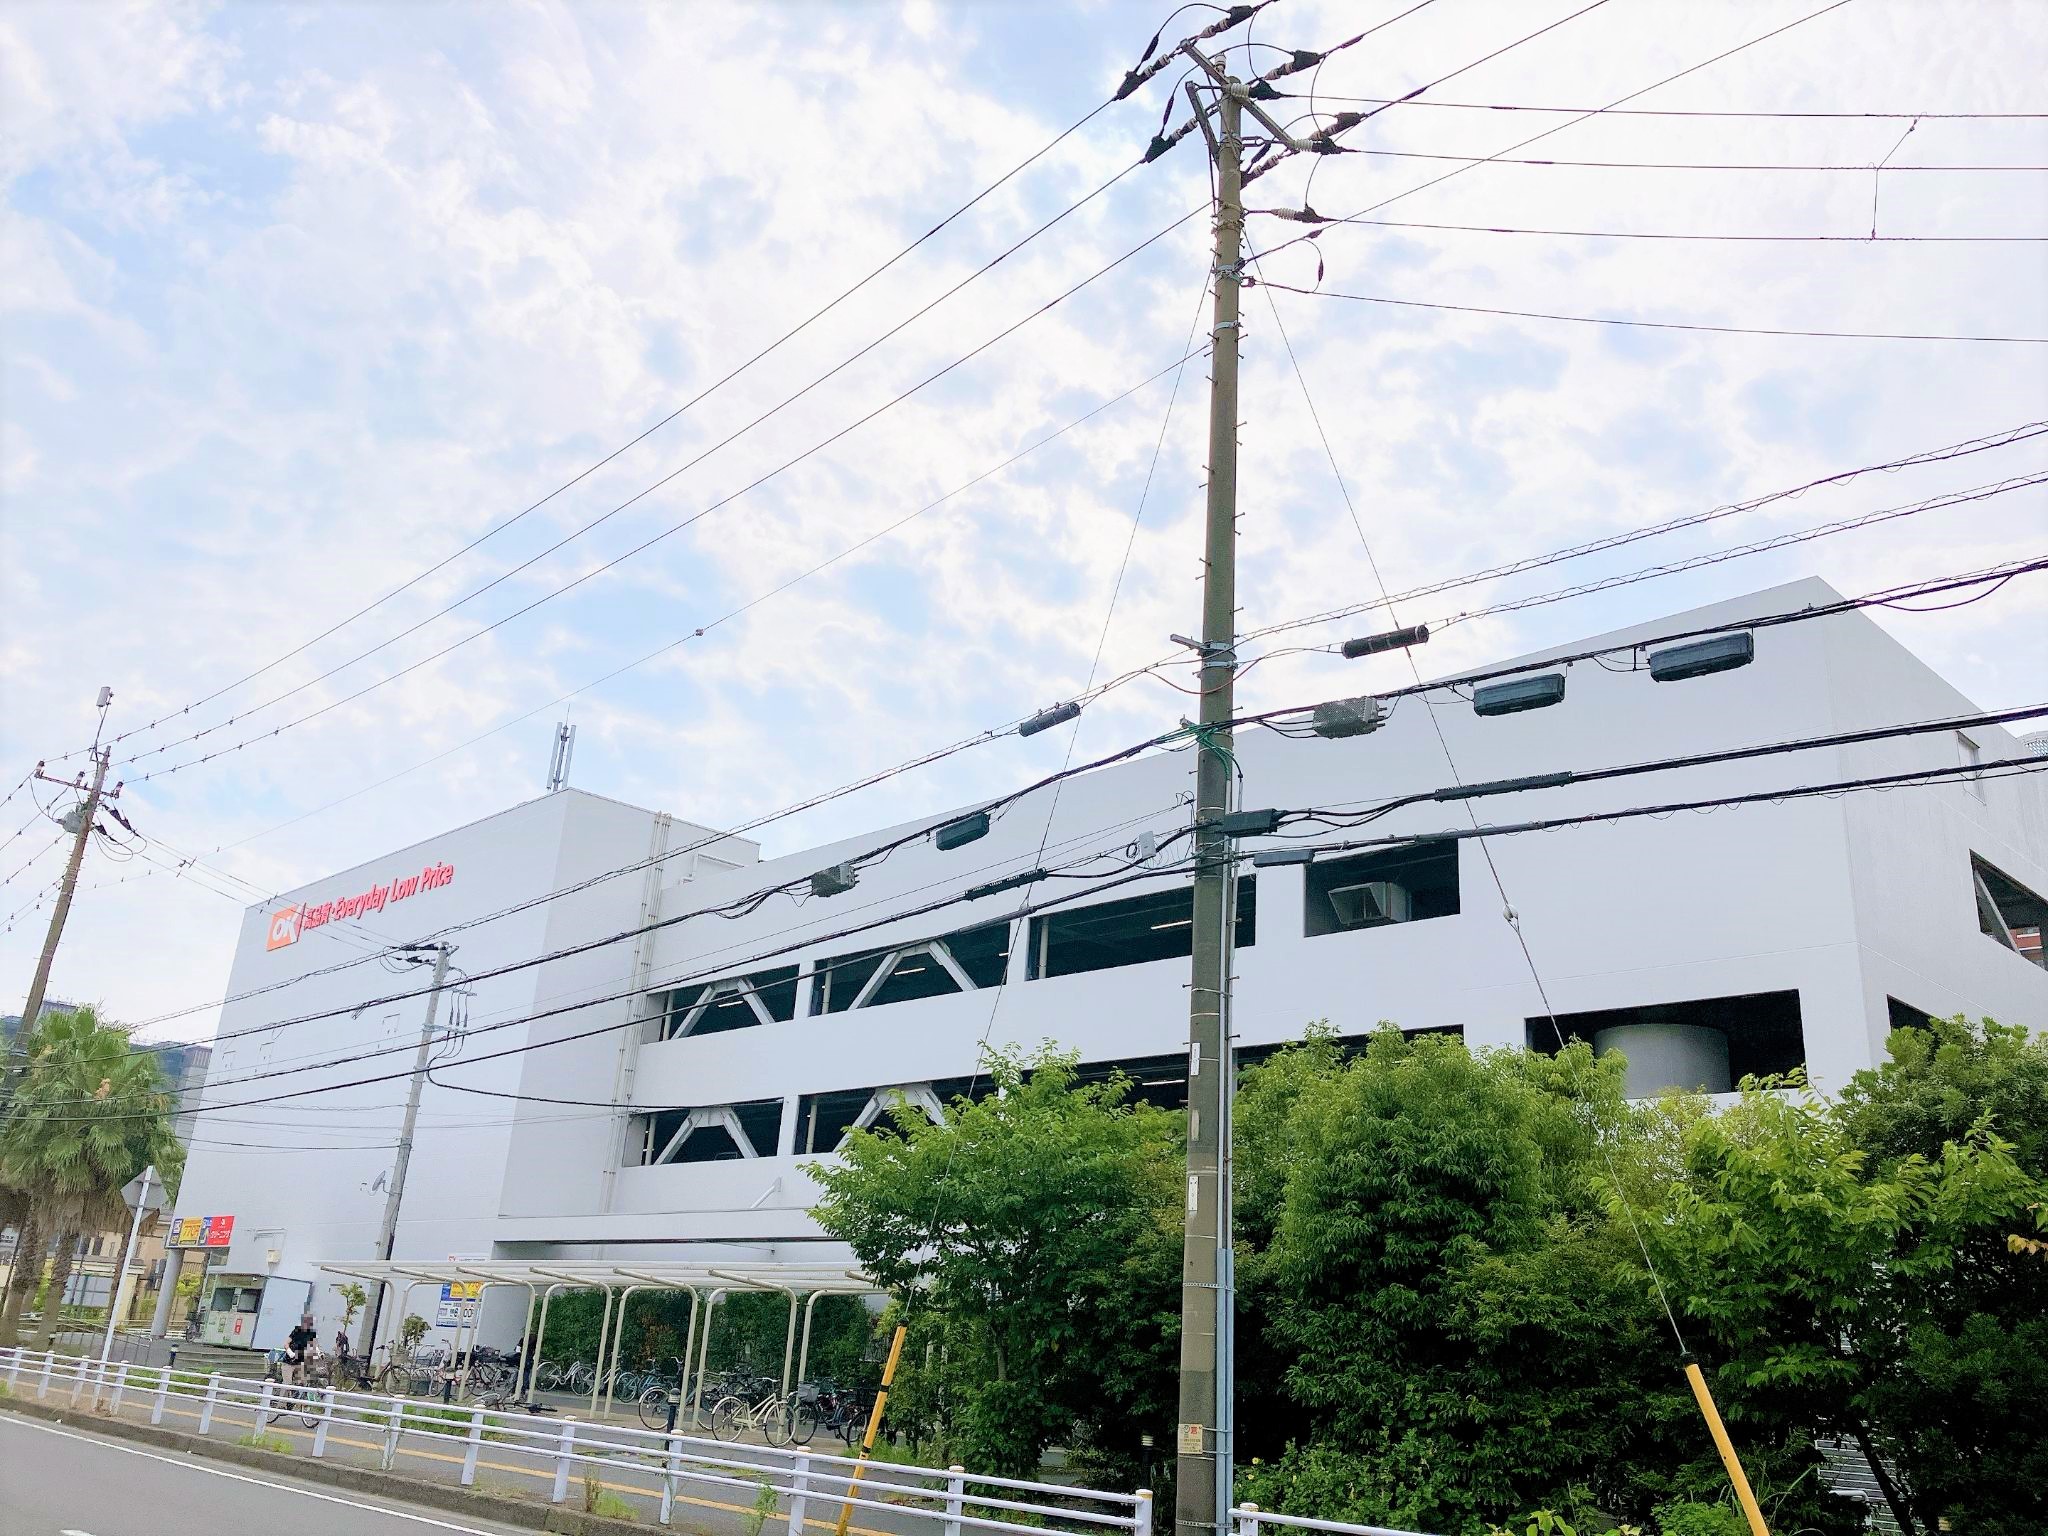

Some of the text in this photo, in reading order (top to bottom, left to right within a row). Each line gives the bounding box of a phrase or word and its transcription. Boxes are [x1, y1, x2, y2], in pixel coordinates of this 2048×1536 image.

[334, 884, 390, 921] Everyday
[390, 877, 420, 902] Low
[419, 861, 454, 892] Price
